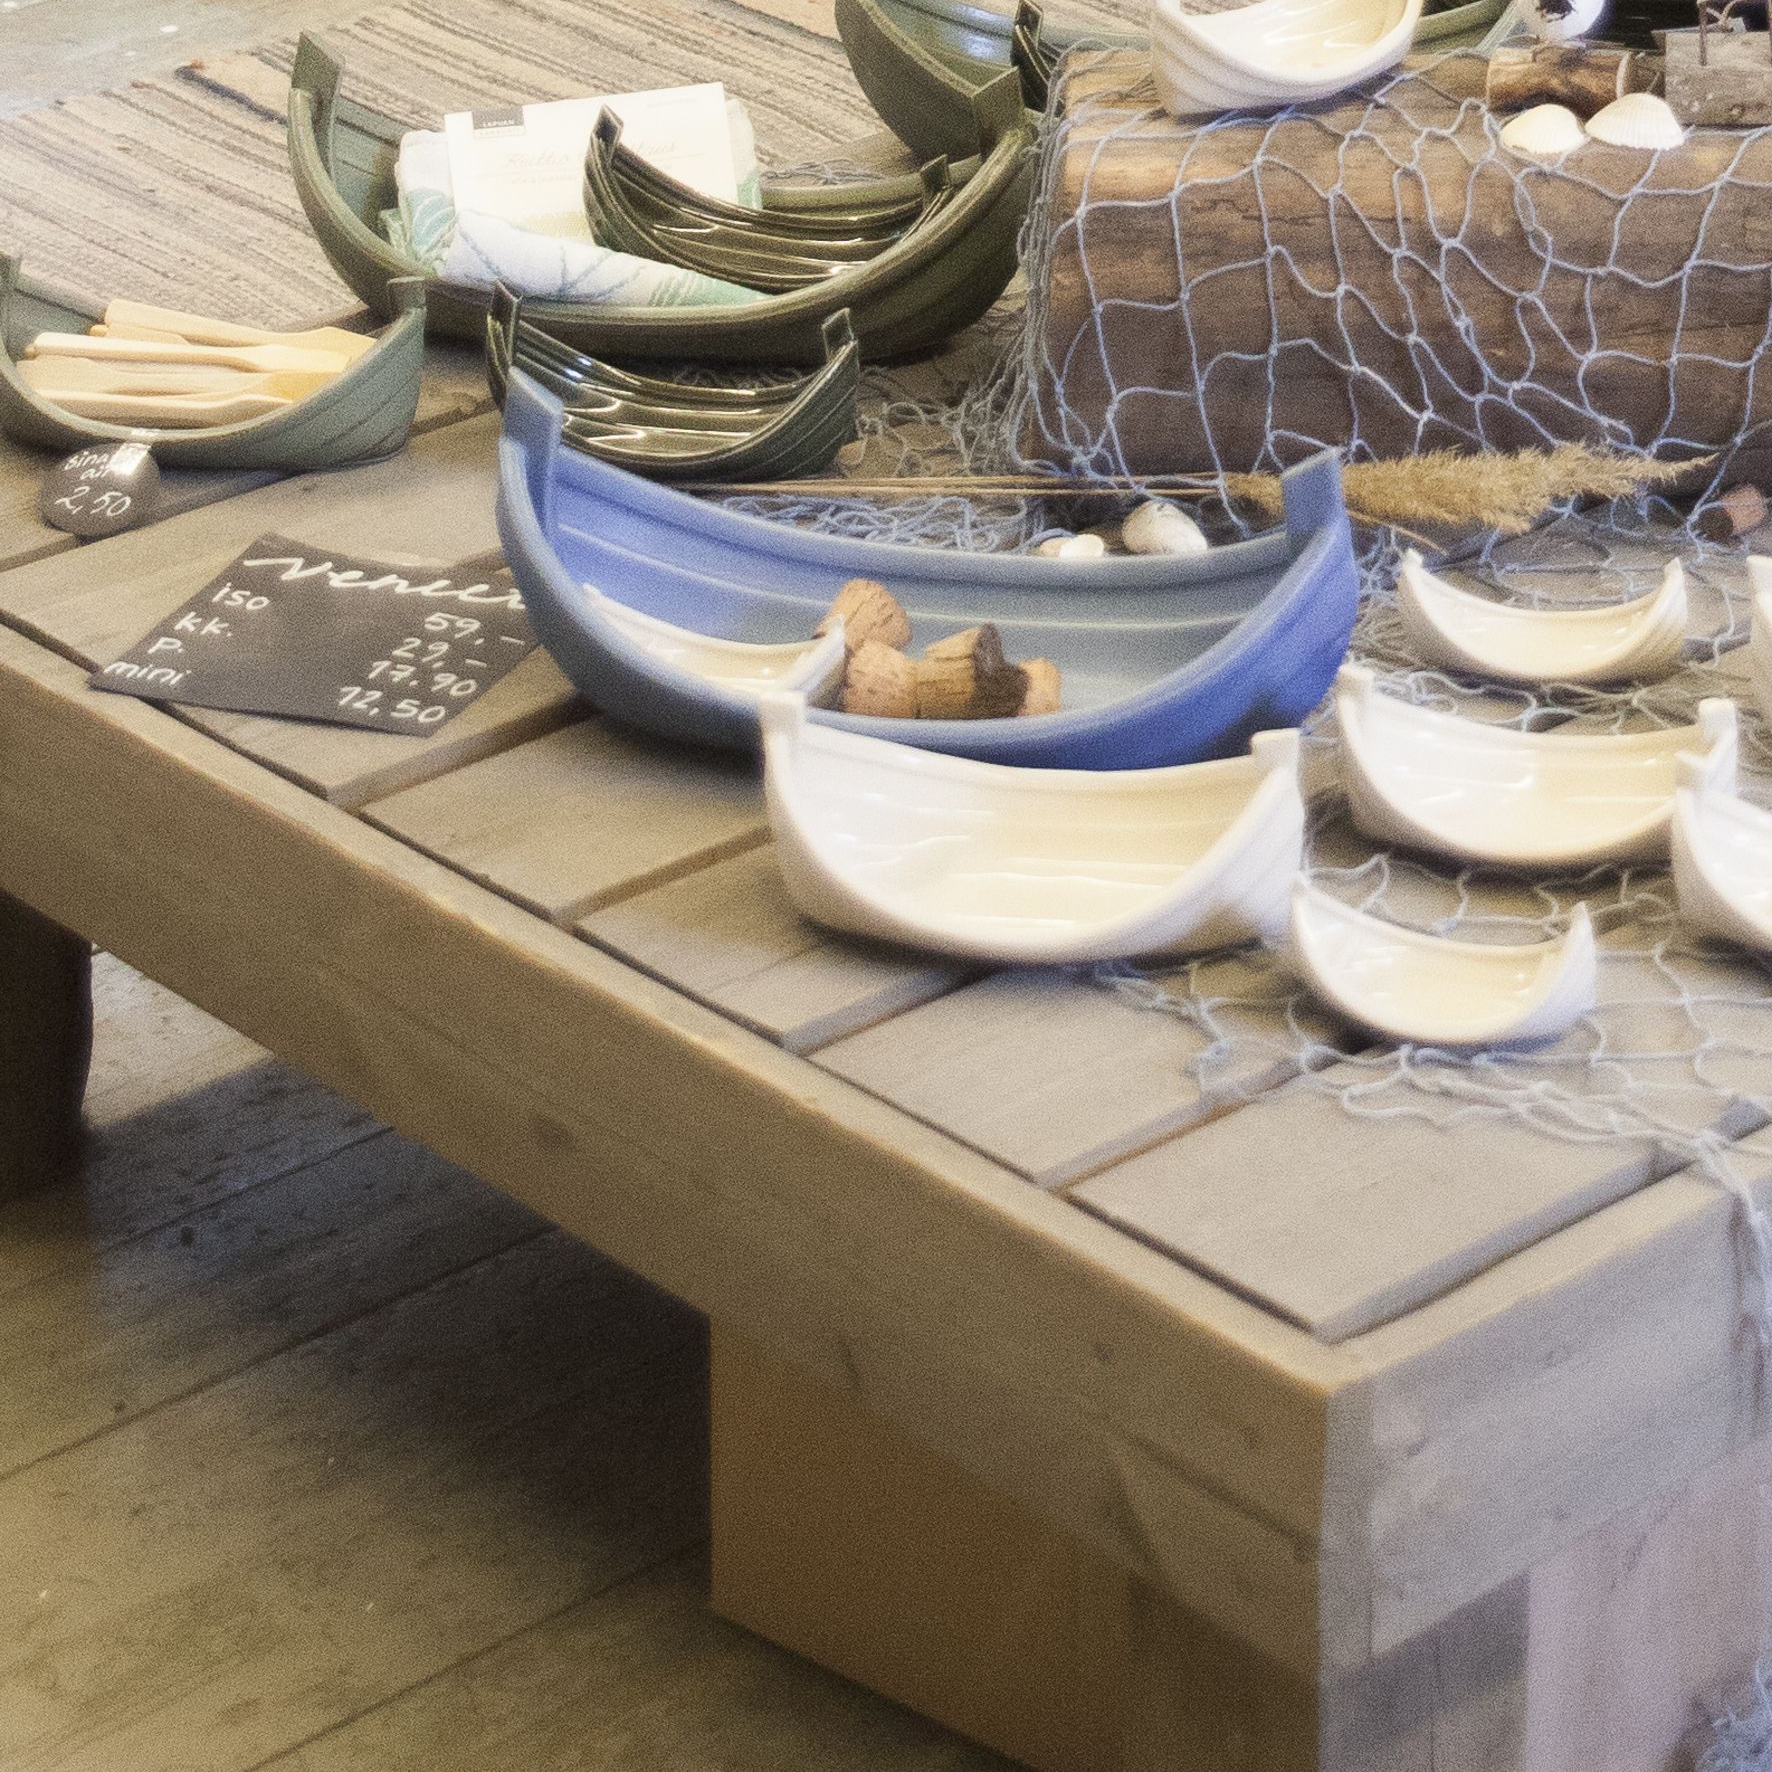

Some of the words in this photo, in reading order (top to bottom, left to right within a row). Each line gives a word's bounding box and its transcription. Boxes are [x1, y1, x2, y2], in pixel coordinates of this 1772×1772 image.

[54, 485, 132, 517] 2,50
[211, 582, 270, 612] iso
[103, 659, 193, 687] mini
[338, 685, 446, 725] 12,50
